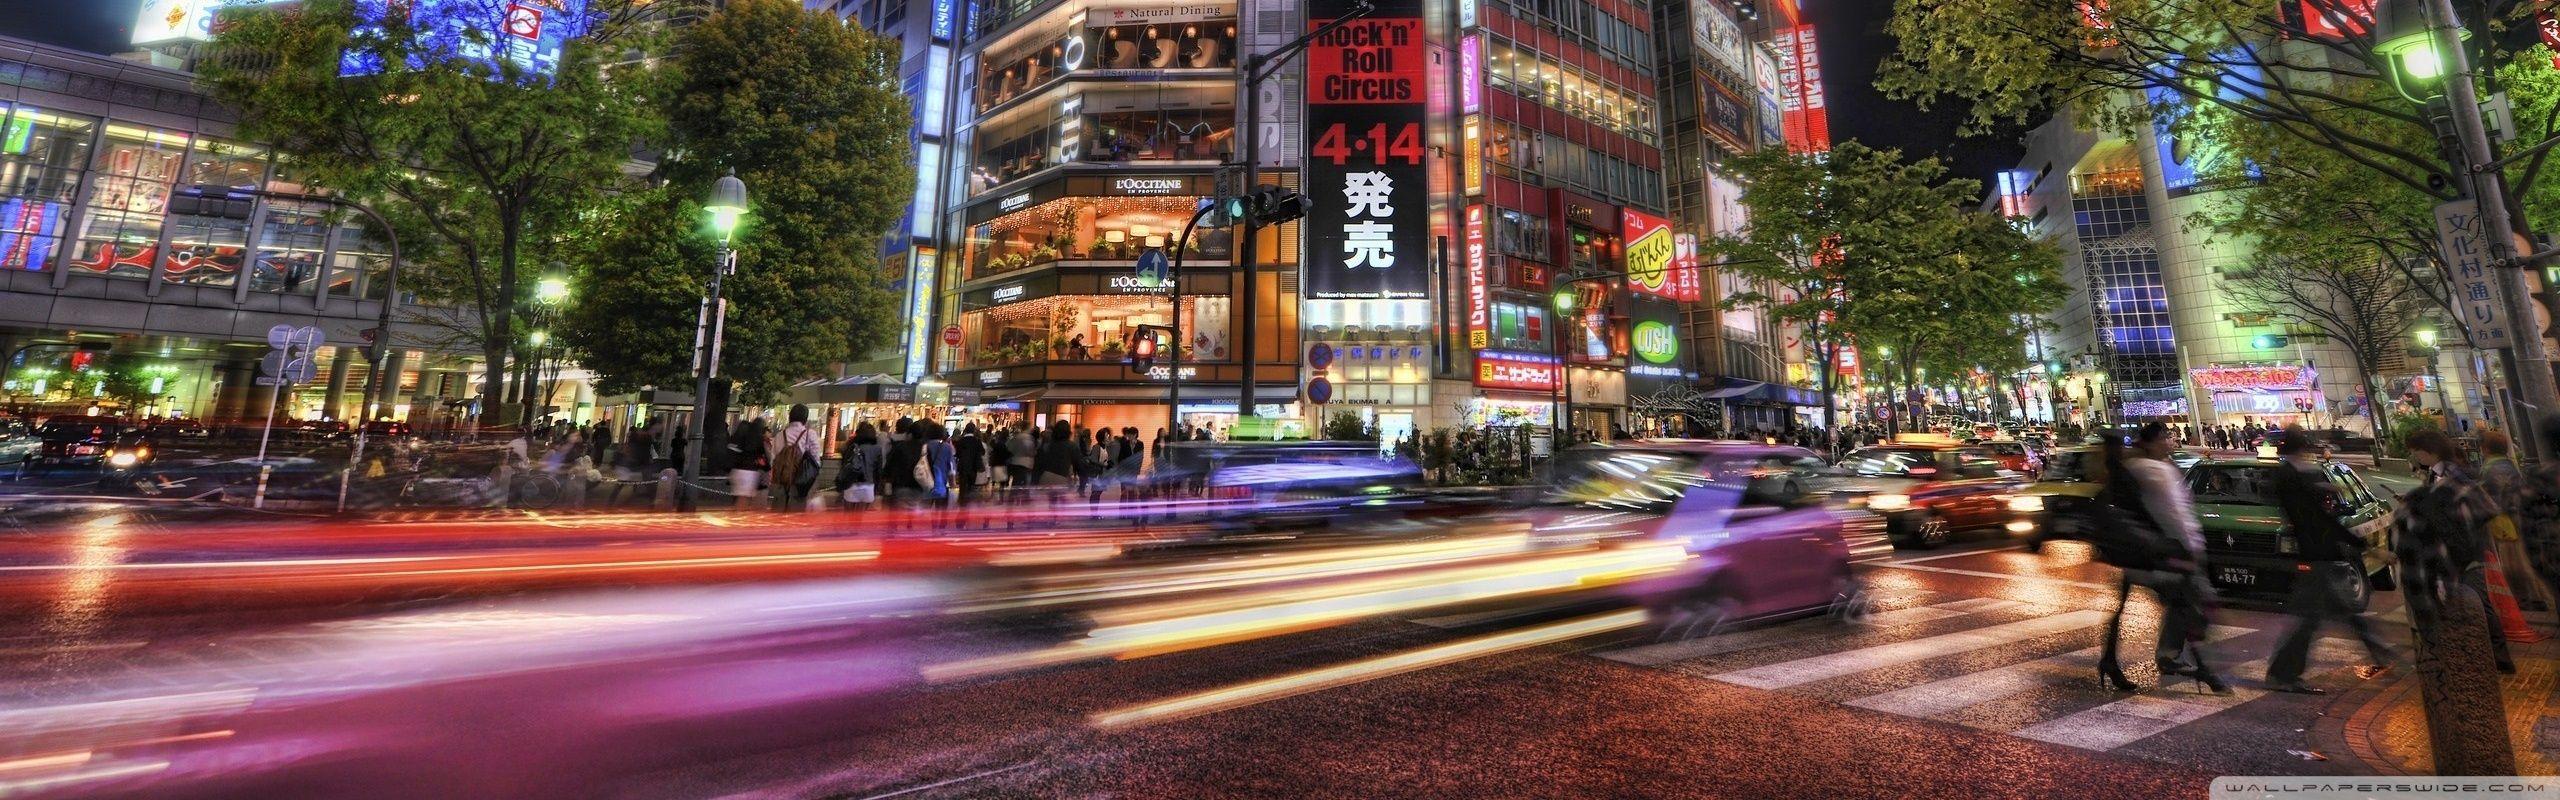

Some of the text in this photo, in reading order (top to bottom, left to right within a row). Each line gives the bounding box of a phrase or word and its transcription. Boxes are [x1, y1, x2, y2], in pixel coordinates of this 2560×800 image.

[1130, 6, 1221, 18] Natural Dining
[1318, 21, 1416, 47] Rock'n'
[1342, 48, 1393, 73] Roll
[1325, 75, 1411, 100] Circus
[1116, 178, 1182, 189] L'OCCITANE
[1342, 170, 1395, 269] 発売
[1629, 234, 1670, 280] むじんくん
[2445, 213, 2494, 324] 文化村通り
[1666, 282, 1677, 296] 3F
[1637, 325, 1674, 354] LUSH
[2477, 327, 2504, 340] 方面
[2224, 573, 2256, 584] 84-77
